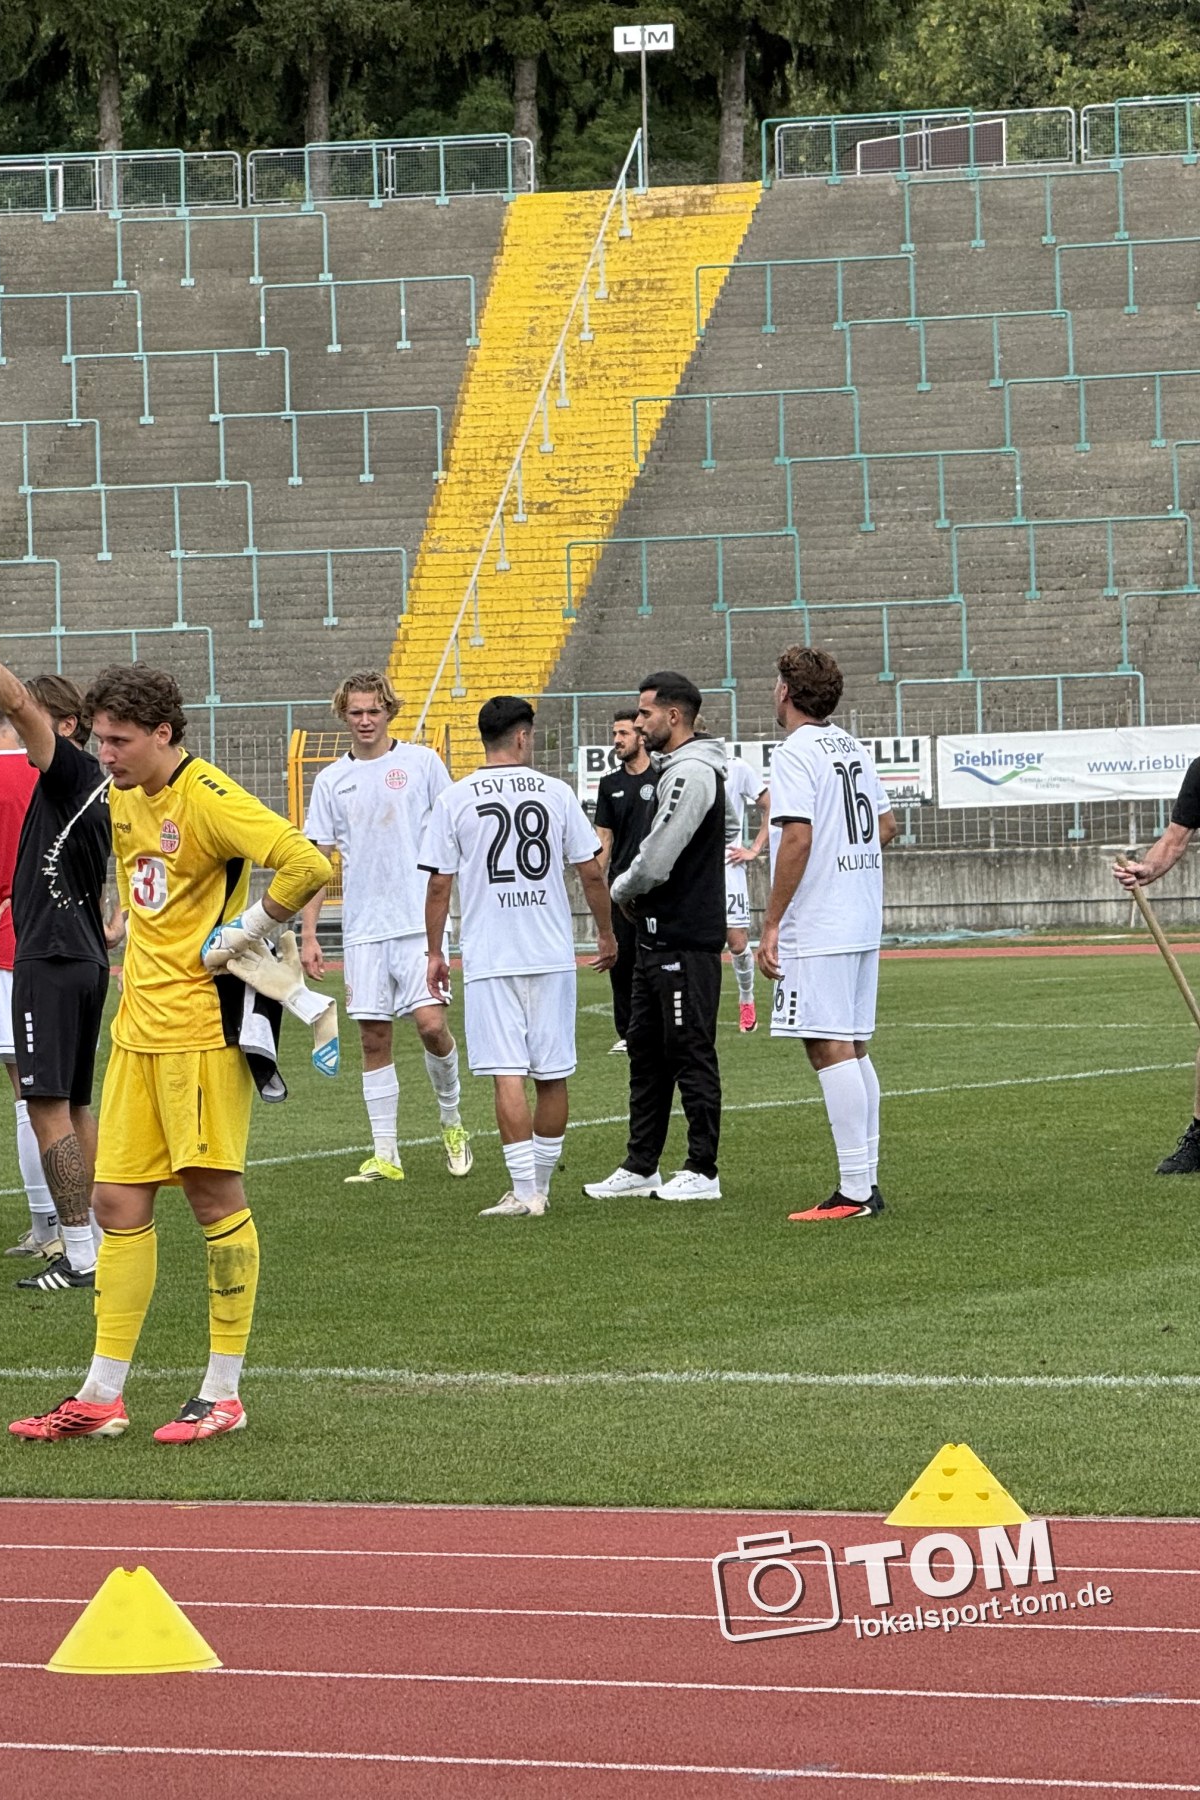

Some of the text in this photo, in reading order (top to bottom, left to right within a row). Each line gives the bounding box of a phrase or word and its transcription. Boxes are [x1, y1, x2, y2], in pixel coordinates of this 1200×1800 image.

[623, 30, 668, 45] L M
[954, 749, 1045, 769] Rieblinger
[470, 777, 546, 797] TSV 1882
[833, 761, 874, 845] 16
[475, 800, 551, 884] 28
[497, 890, 548, 908] YILMAZ
[728, 893, 745, 914] 24
